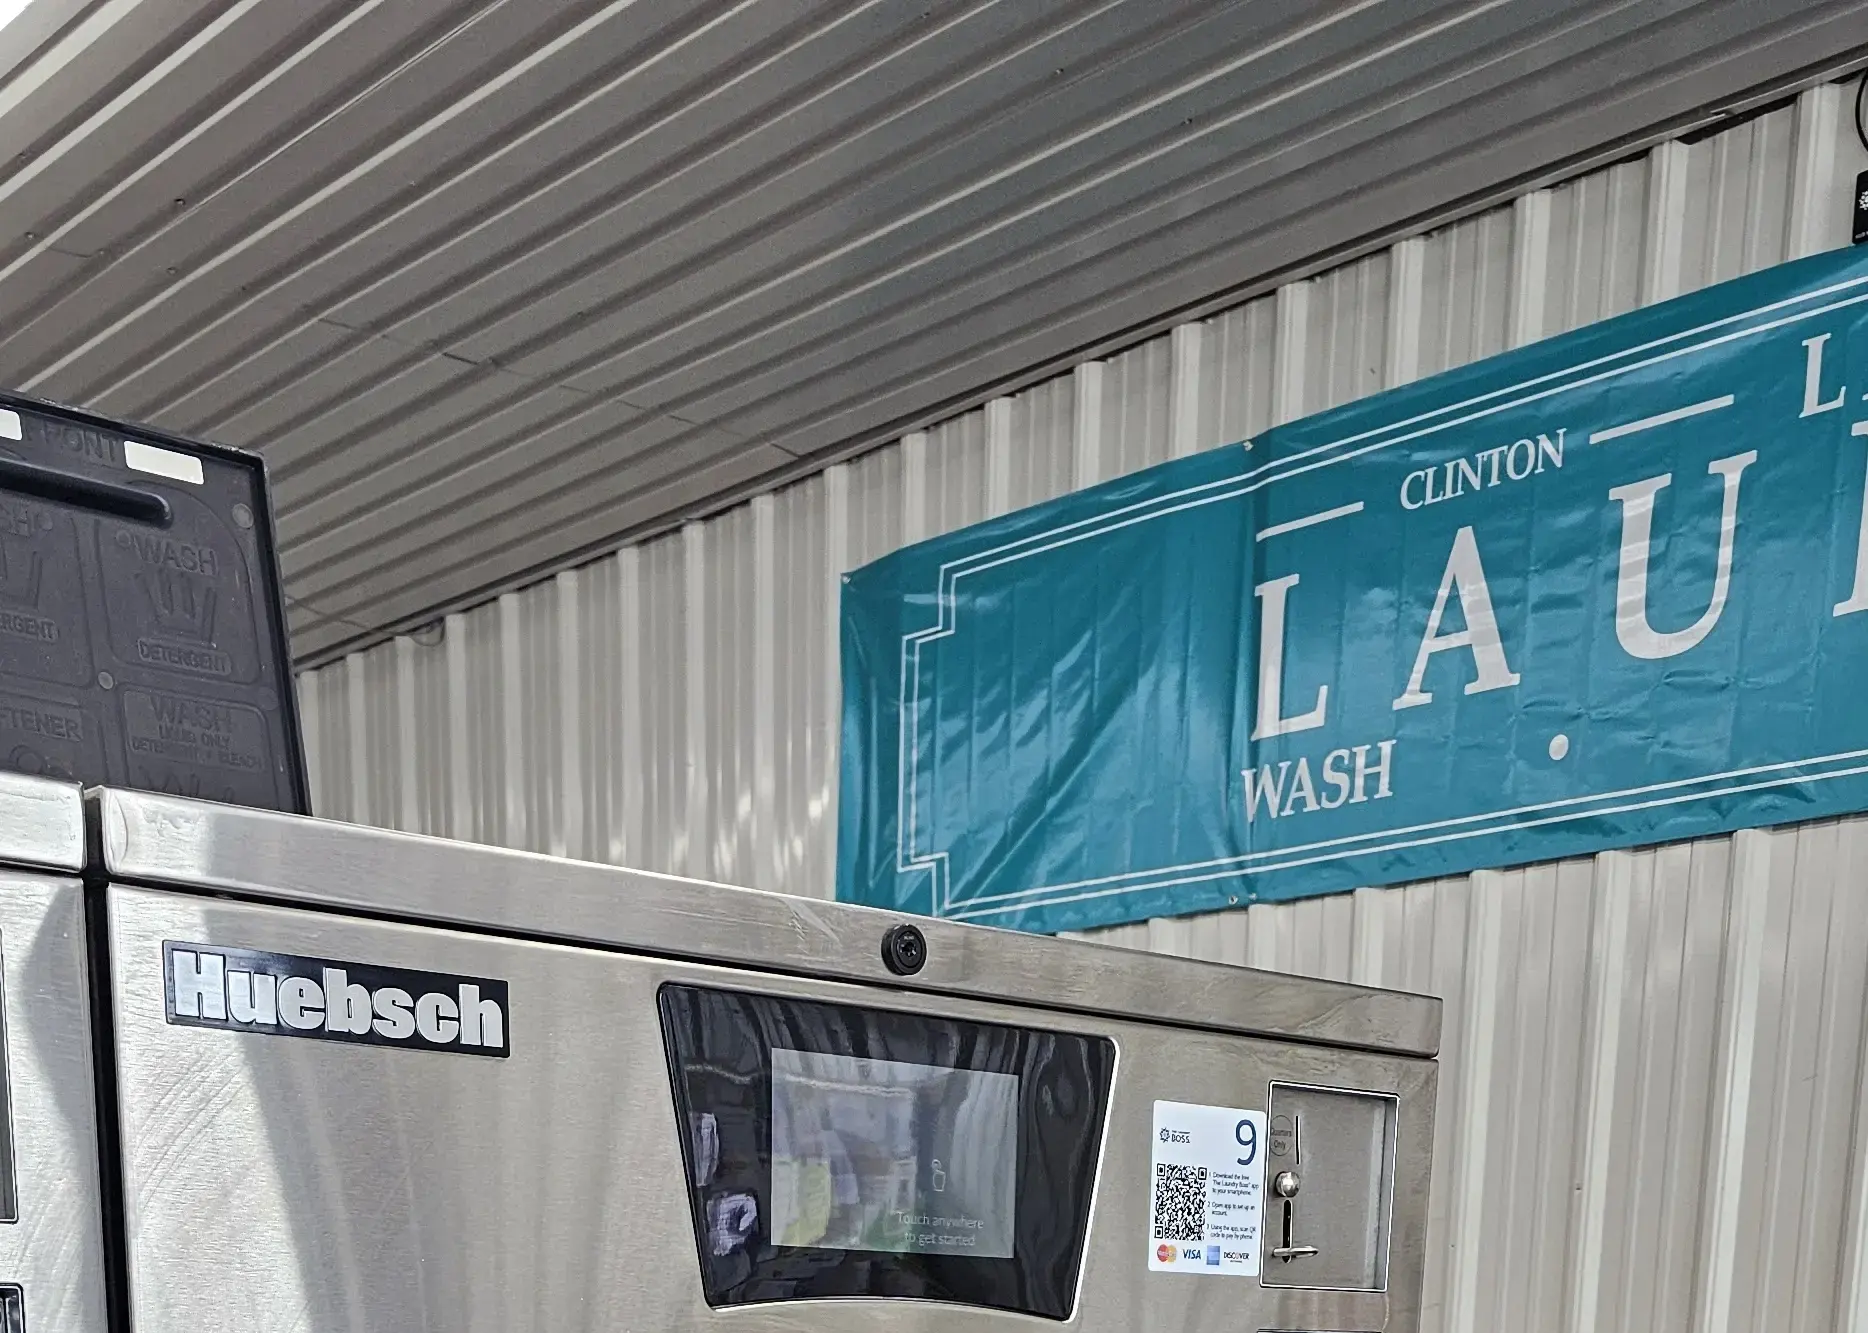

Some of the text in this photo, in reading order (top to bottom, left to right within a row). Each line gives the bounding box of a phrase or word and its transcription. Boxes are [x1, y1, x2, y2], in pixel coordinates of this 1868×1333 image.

[1400, 428, 1567, 510] CLINTON
[134, 535, 218, 575] WASH
[1241, 739, 1397, 823] WASH
[171, 949, 504, 1049] Huebsch
[1235, 1119, 1257, 1166] 9
[896, 1210, 930, 1225] Touch
[1182, 1249, 1202, 1260] VISA
[1223, 1251, 1250, 1260] DISCOVER
